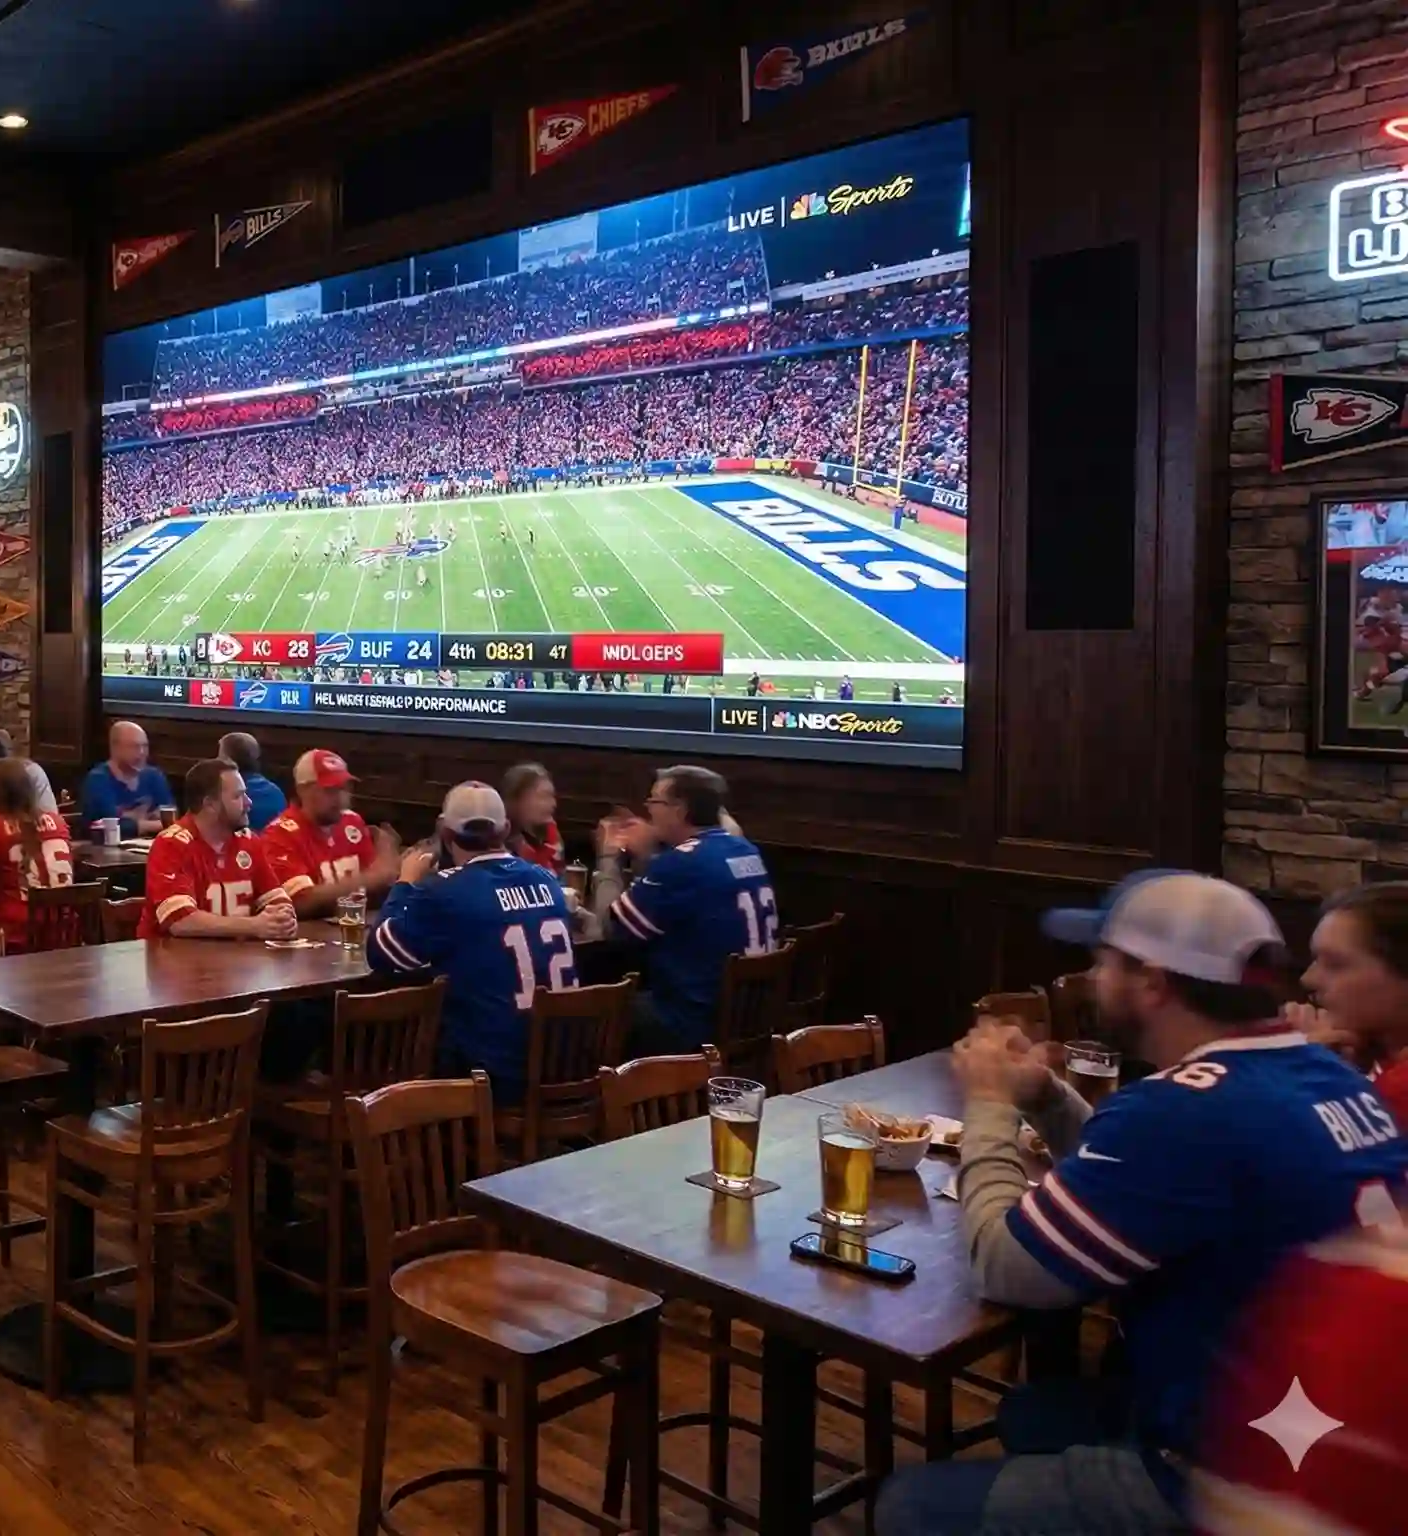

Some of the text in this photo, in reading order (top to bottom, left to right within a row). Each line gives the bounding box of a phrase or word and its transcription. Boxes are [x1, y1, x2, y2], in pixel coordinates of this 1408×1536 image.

[588, 92, 649, 137] CHIEFS
[246, 208, 283, 240] BILLS
[727, 175, 914, 233] LIVE Sports
[1314, 396, 1373, 427] KC
[711, 498, 967, 592] BILLS
[252, 640, 272, 657] KC
[288, 639, 310, 658] 28
[360, 640, 393, 659] BUF
[407, 640, 433, 660] 24
[448, 641, 477, 660] 4th
[485, 641, 534, 661] 08:31
[549, 644, 568, 660] 47
[721, 710, 759, 726] LIVE
[503, 919, 580, 1010] 12
[1312, 1091, 1399, 1153] BILLS
